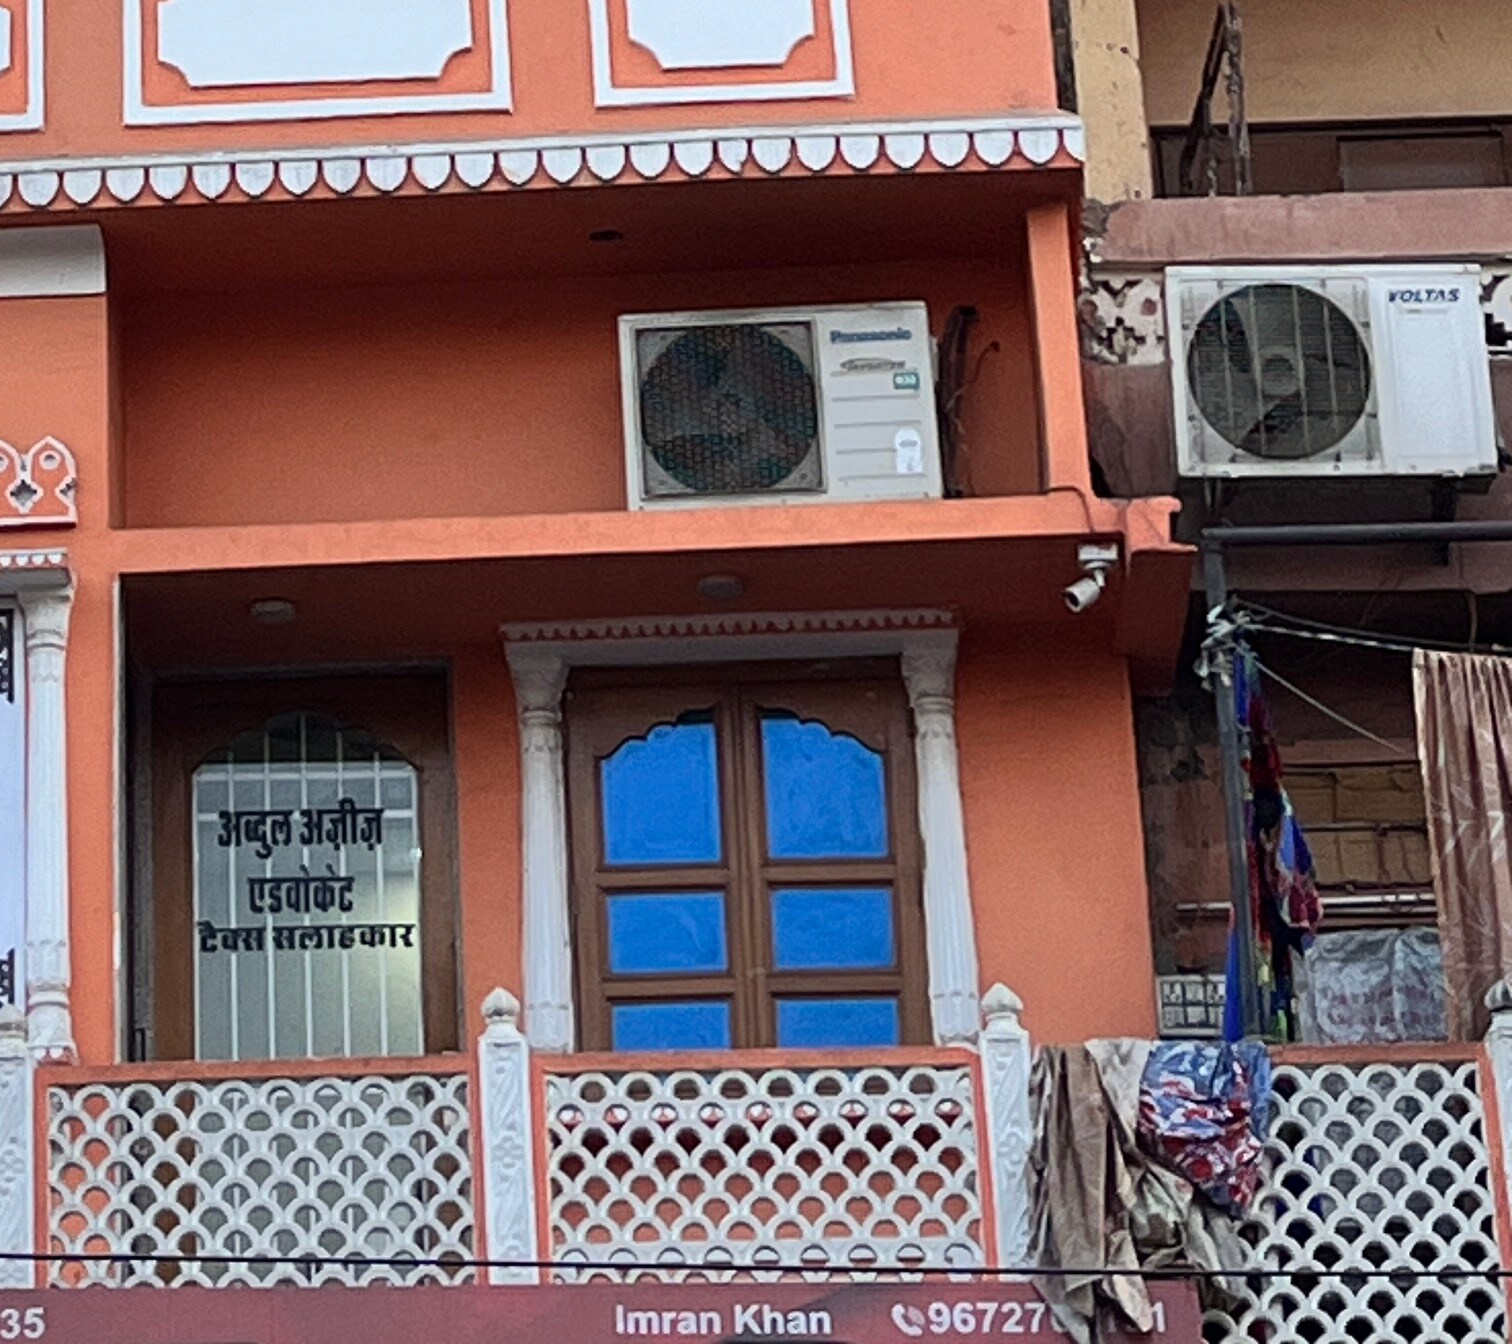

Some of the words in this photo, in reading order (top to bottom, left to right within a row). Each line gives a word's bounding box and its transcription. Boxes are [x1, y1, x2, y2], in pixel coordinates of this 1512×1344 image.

[1387, 288, 1460, 304] VOLTAS
[218, 810, 293, 859] अब्दुल
[299, 798, 384, 850] अज़ीज़
[248, 864, 355, 914] एडवोकेट
[197, 920, 265, 954] टैक्स
[271, 923, 416, 951] सलाहकार
[615, 1304, 722, 1335] Imran
[734, 1304, 832, 1335] Khan
